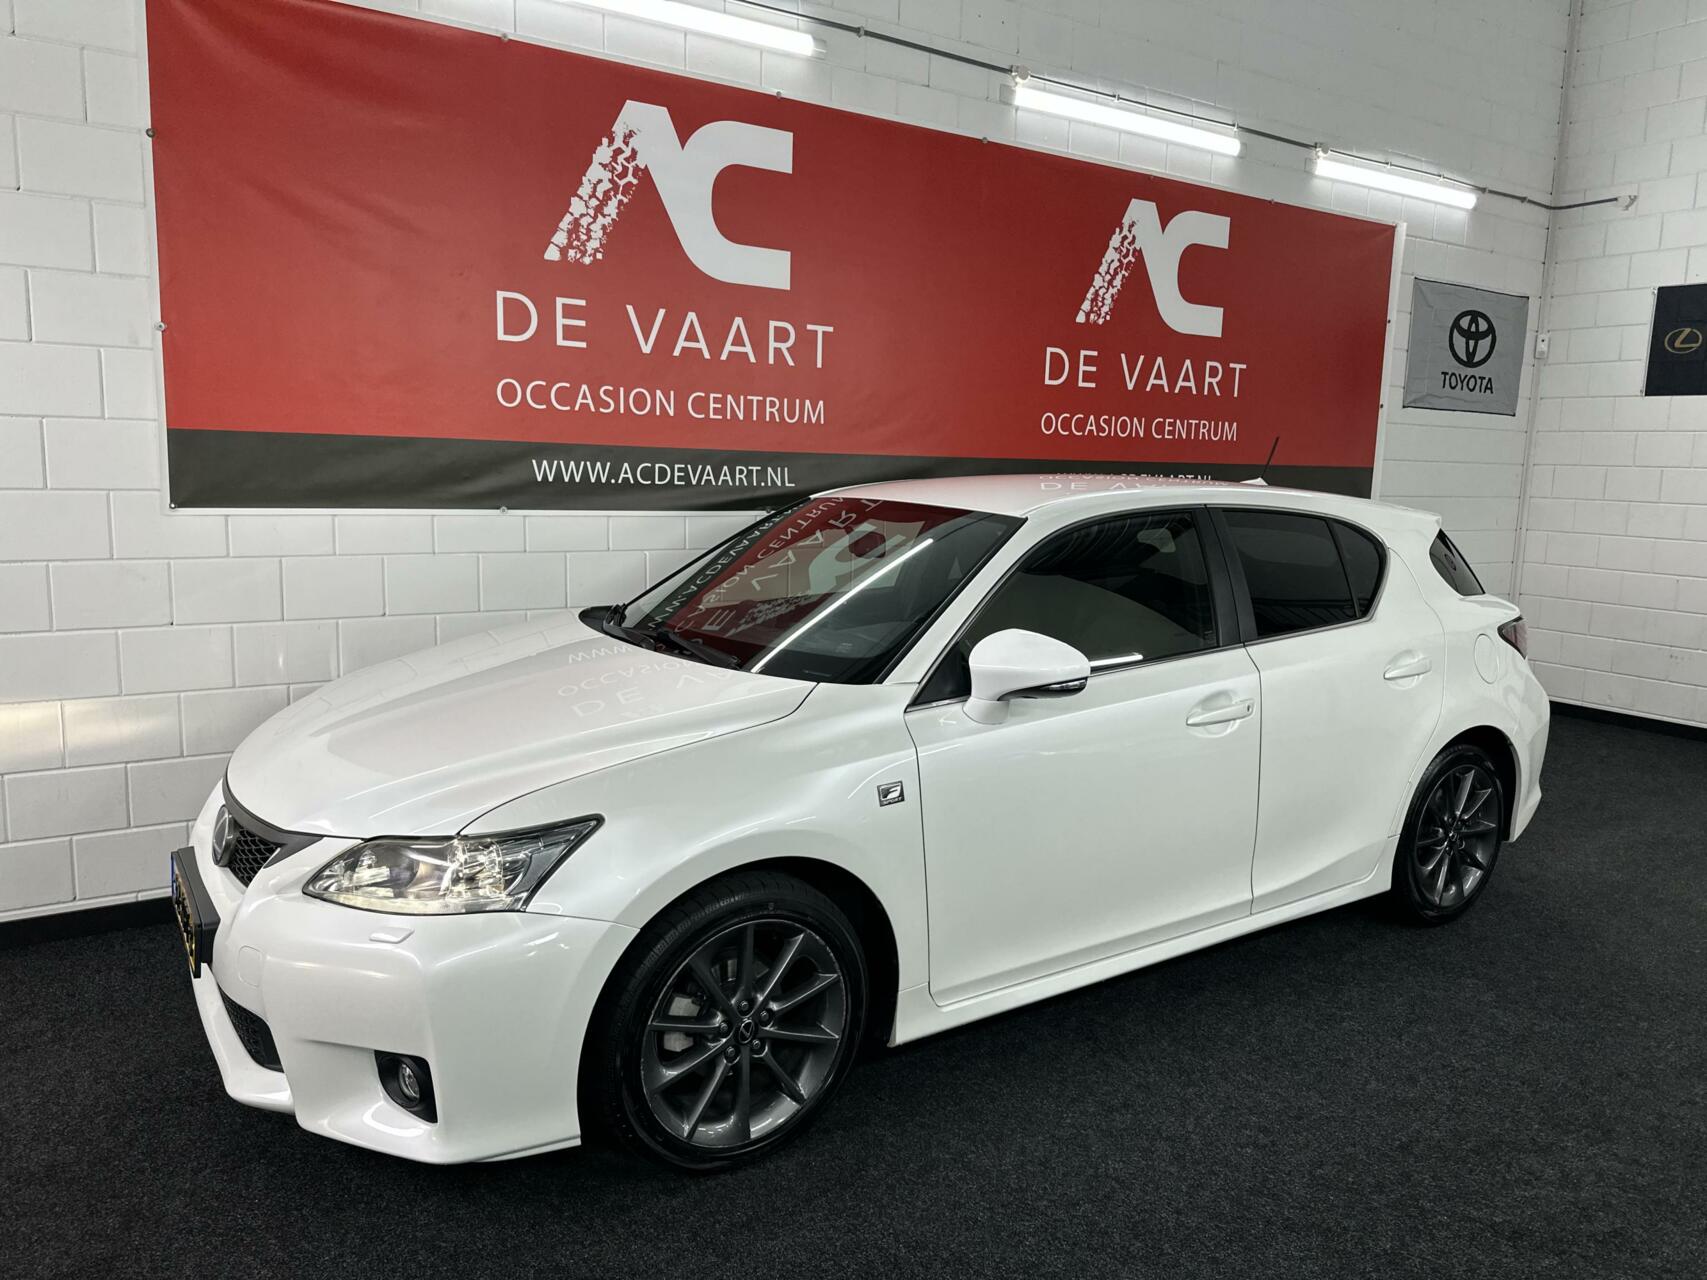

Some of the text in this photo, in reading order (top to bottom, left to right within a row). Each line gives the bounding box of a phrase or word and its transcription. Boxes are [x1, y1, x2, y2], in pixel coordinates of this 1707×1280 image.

[495, 289, 834, 369] DE VAART
[1044, 346, 1247, 398] DE VAART
[1440, 371, 1494, 395] TOYOTA
[496, 377, 826, 425] OCCASION CENTRUM
[1040, 412, 1237, 441] OCCASION CENTRUM
[531, 458, 796, 487] WWW.ACDEVAART.NL
